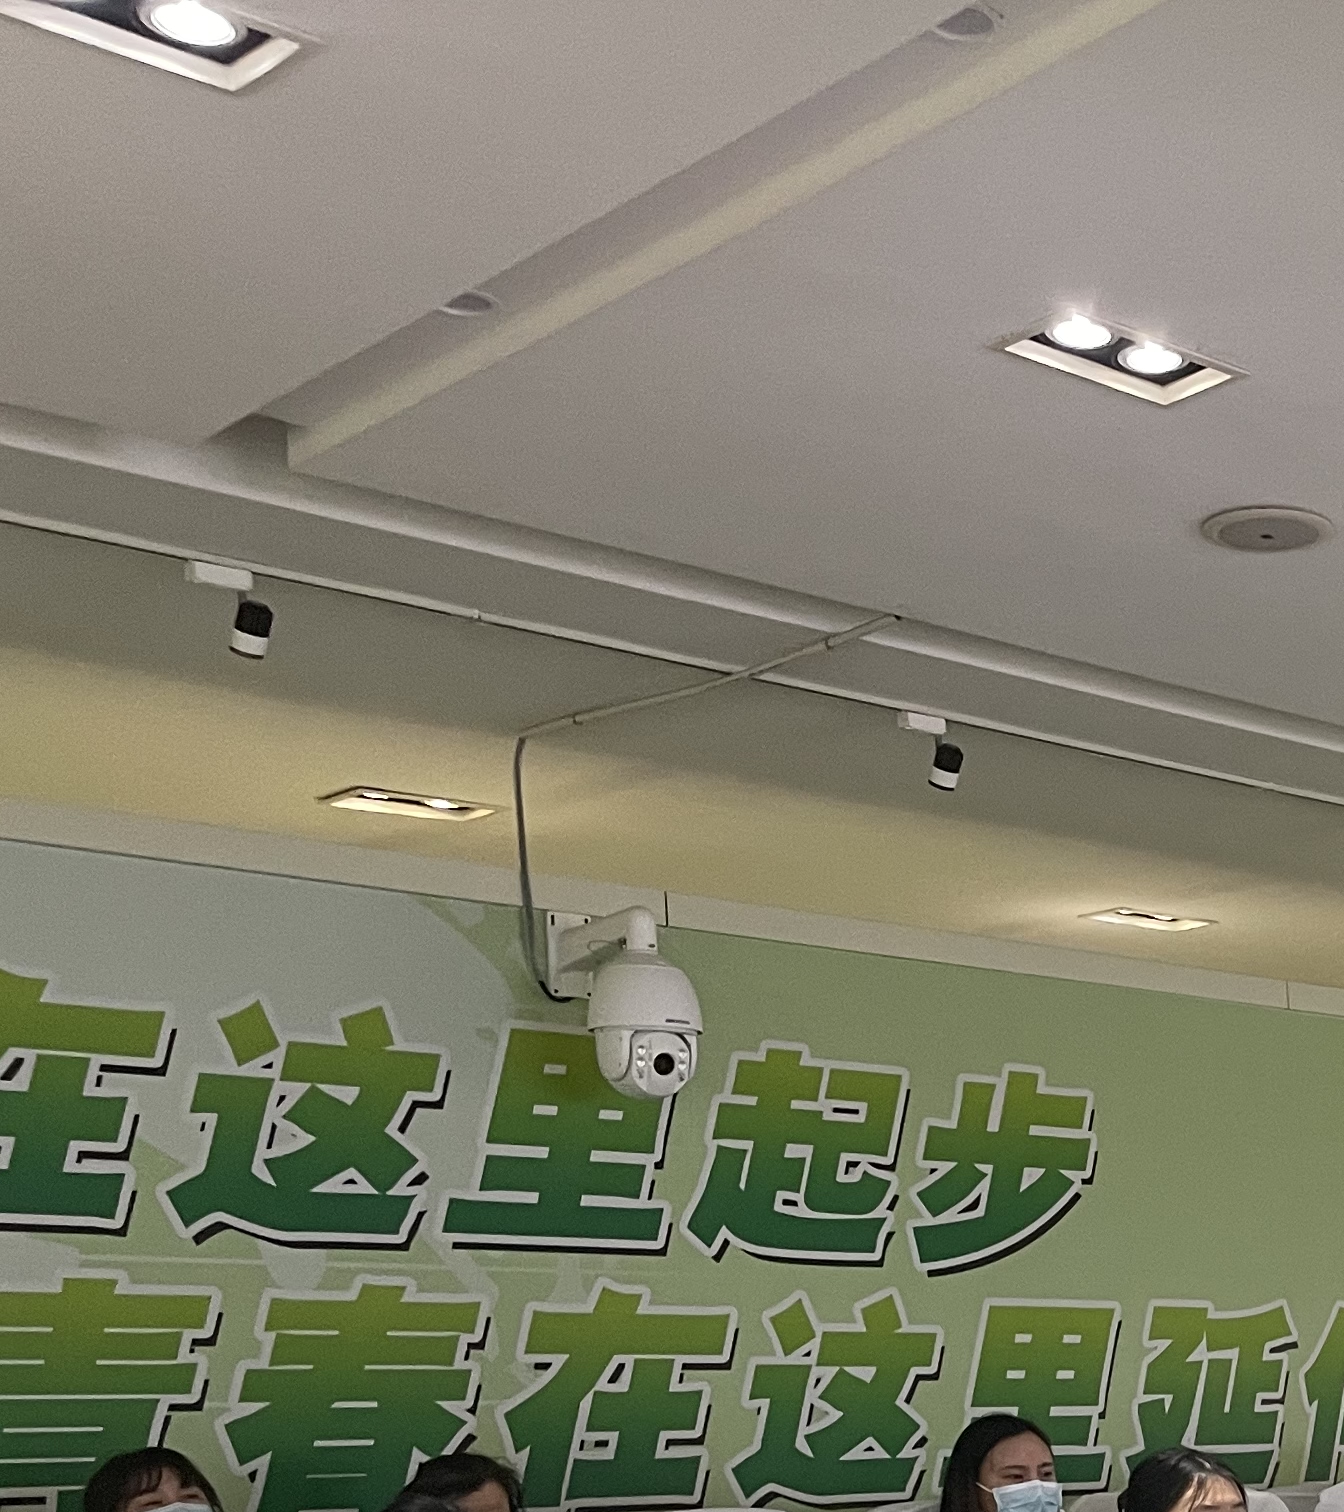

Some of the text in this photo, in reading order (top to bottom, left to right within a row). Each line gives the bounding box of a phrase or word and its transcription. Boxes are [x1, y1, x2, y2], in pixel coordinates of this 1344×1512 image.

[0, 968, 1096, 1276] 在这里起步
